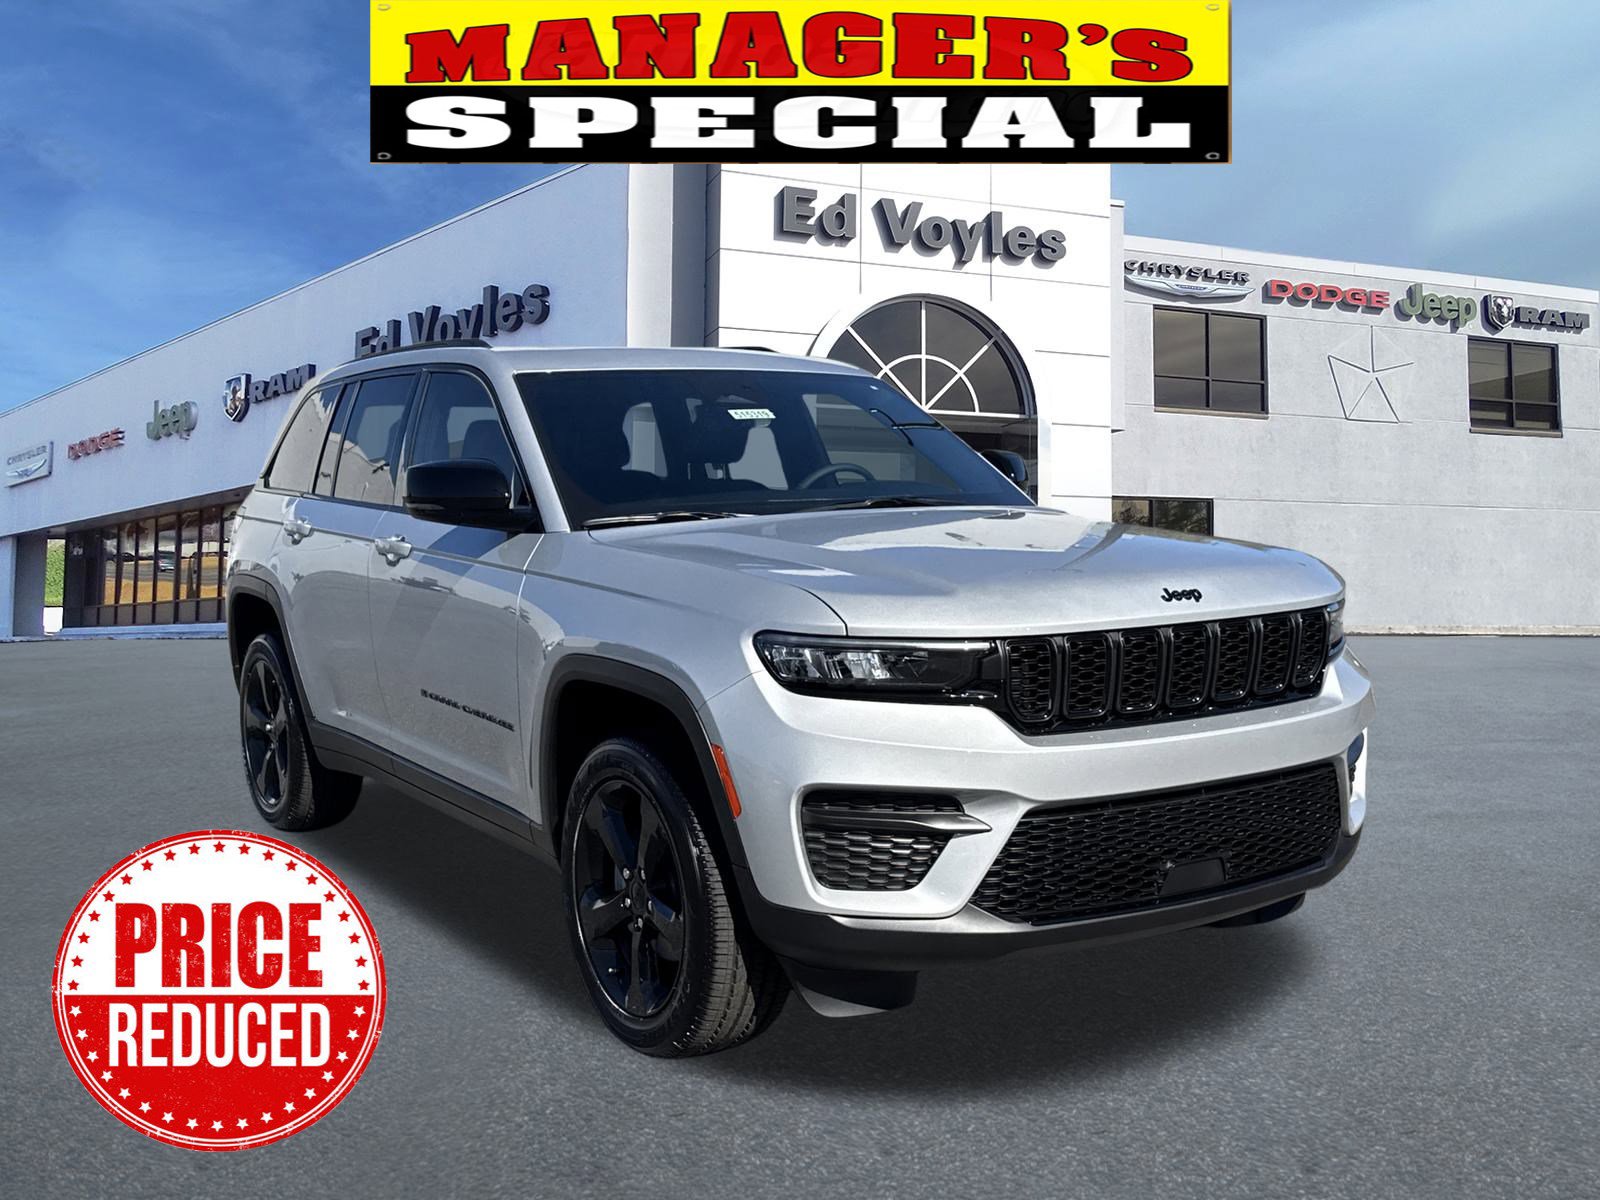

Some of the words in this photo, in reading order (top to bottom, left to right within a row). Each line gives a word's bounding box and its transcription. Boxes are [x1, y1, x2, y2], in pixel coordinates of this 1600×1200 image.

[774, 185, 857, 247] Ed
[871, 198, 1067, 270] Voyles
[1124, 259, 1250, 286] CHRYSLER
[1262, 279, 1390, 315] DODGE
[1394, 282, 1478, 333] Jeep
[355, 318, 402, 358] Ed
[408, 284, 550, 345] Voyles
[1514, 305, 1590, 334] RAM
[249, 363, 316, 404] RAM
[146, 400, 199, 440] Jeep
[6, 444, 49, 466] CHRYSLER
[67, 427, 126, 460] DODGE
[1160, 587, 1203, 603] Jeep
